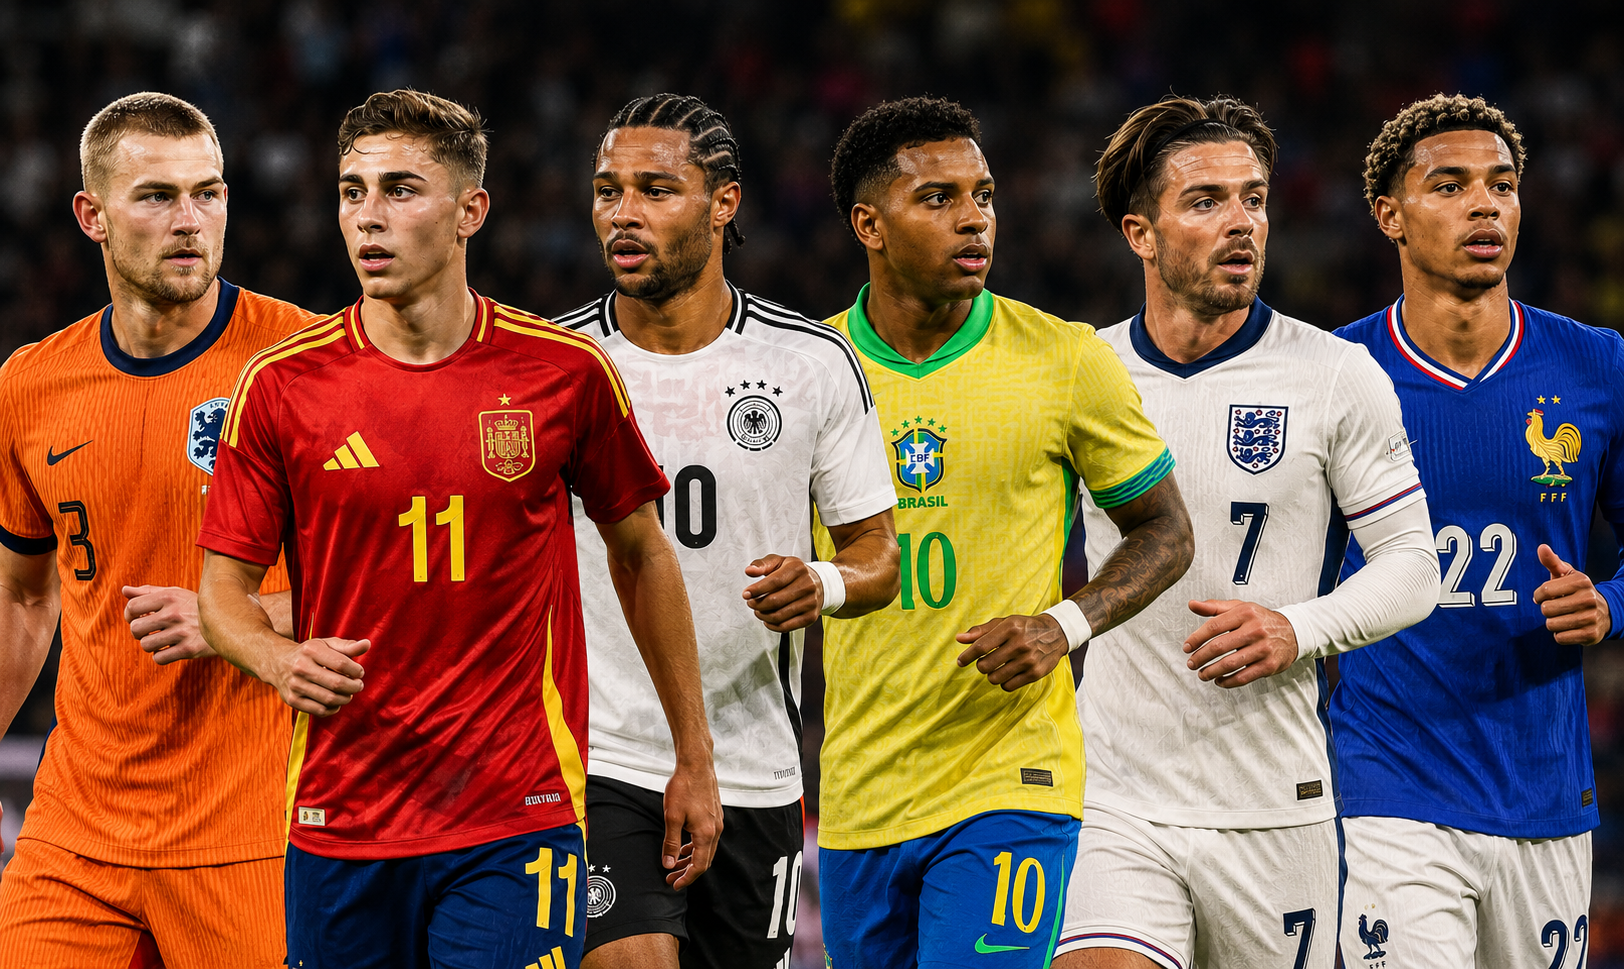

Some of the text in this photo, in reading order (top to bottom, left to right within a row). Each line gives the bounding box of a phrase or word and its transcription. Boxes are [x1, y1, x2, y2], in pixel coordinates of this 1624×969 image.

[910, 453, 930, 463] CBF
[58, 500, 97, 581] 3
[398, 495, 465, 583] 11
[655, 464, 717, 549] 0
[897, 495, 949, 510] BRASIL
[1230, 501, 1270, 585] 7
[897, 531, 957, 611] 10
[1435, 523, 1518, 608] 22
[525, 847, 578, 938] 11
[766, 850, 803, 939] 10
[991, 851, 1046, 934] 10
[1283, 907, 1316, 969] 7
